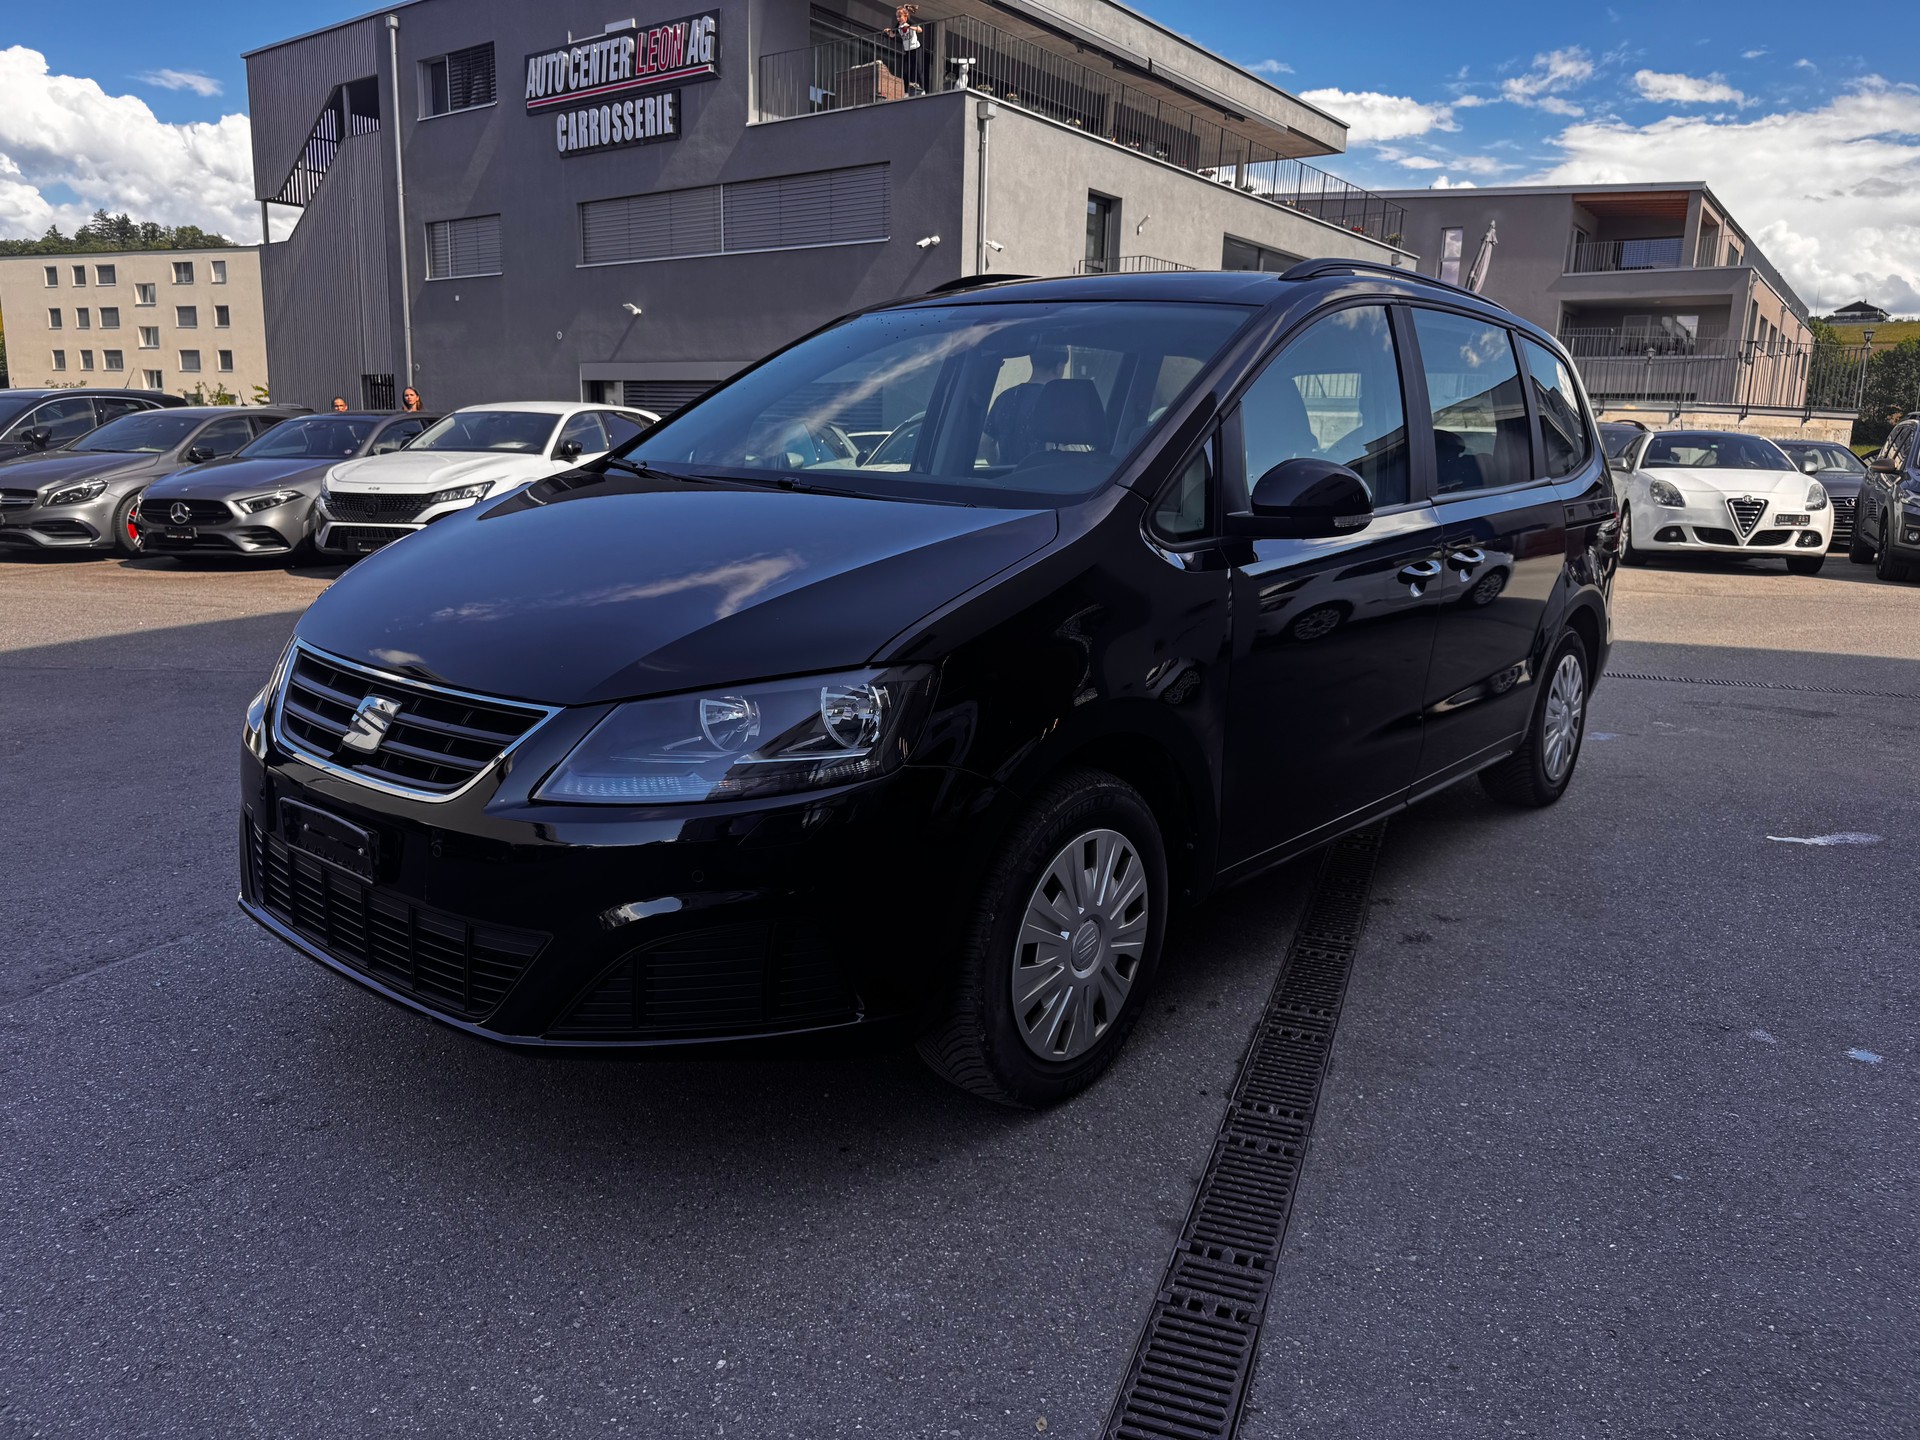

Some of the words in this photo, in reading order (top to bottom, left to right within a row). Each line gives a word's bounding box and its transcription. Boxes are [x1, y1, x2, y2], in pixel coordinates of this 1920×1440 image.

[636, 23, 687, 75] LEON
[686, 15, 716, 66] AG
[556, 93, 676, 152] CARROSSERIE
